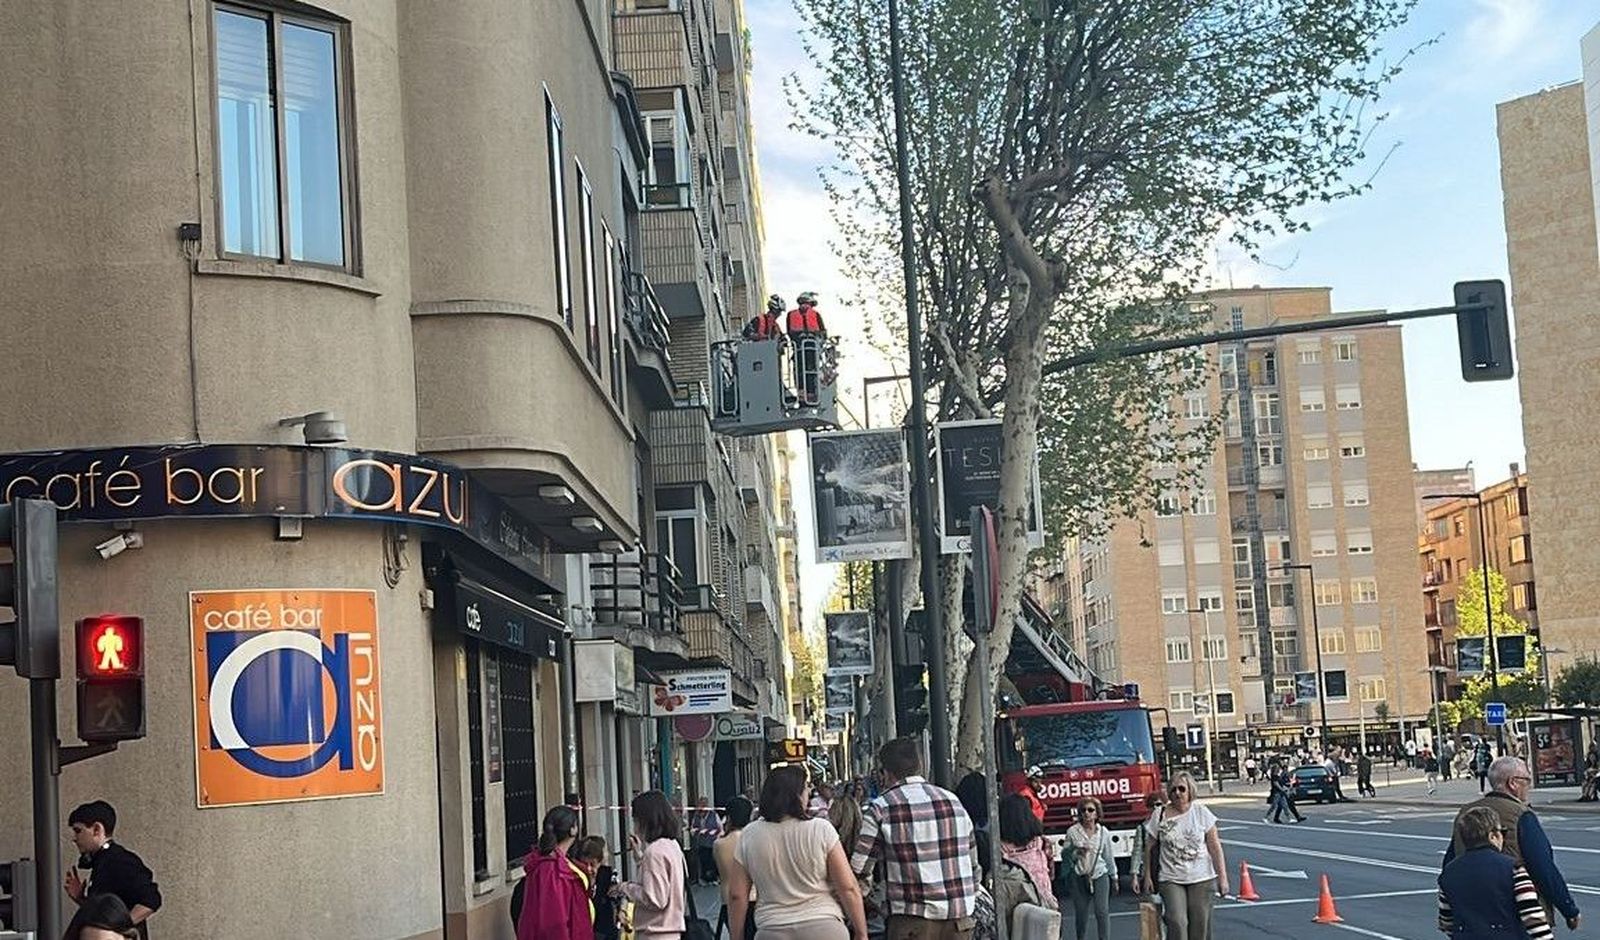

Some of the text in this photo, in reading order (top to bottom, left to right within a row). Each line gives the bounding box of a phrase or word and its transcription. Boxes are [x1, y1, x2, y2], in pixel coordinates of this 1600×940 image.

[944, 446, 1001, 467] TES
[6, 455, 141, 511] café
[166, 458, 264, 504] bar
[204, 603, 323, 630] café bar
[348, 632, 377, 772] azul
[1189, 728, 1201, 744] T
